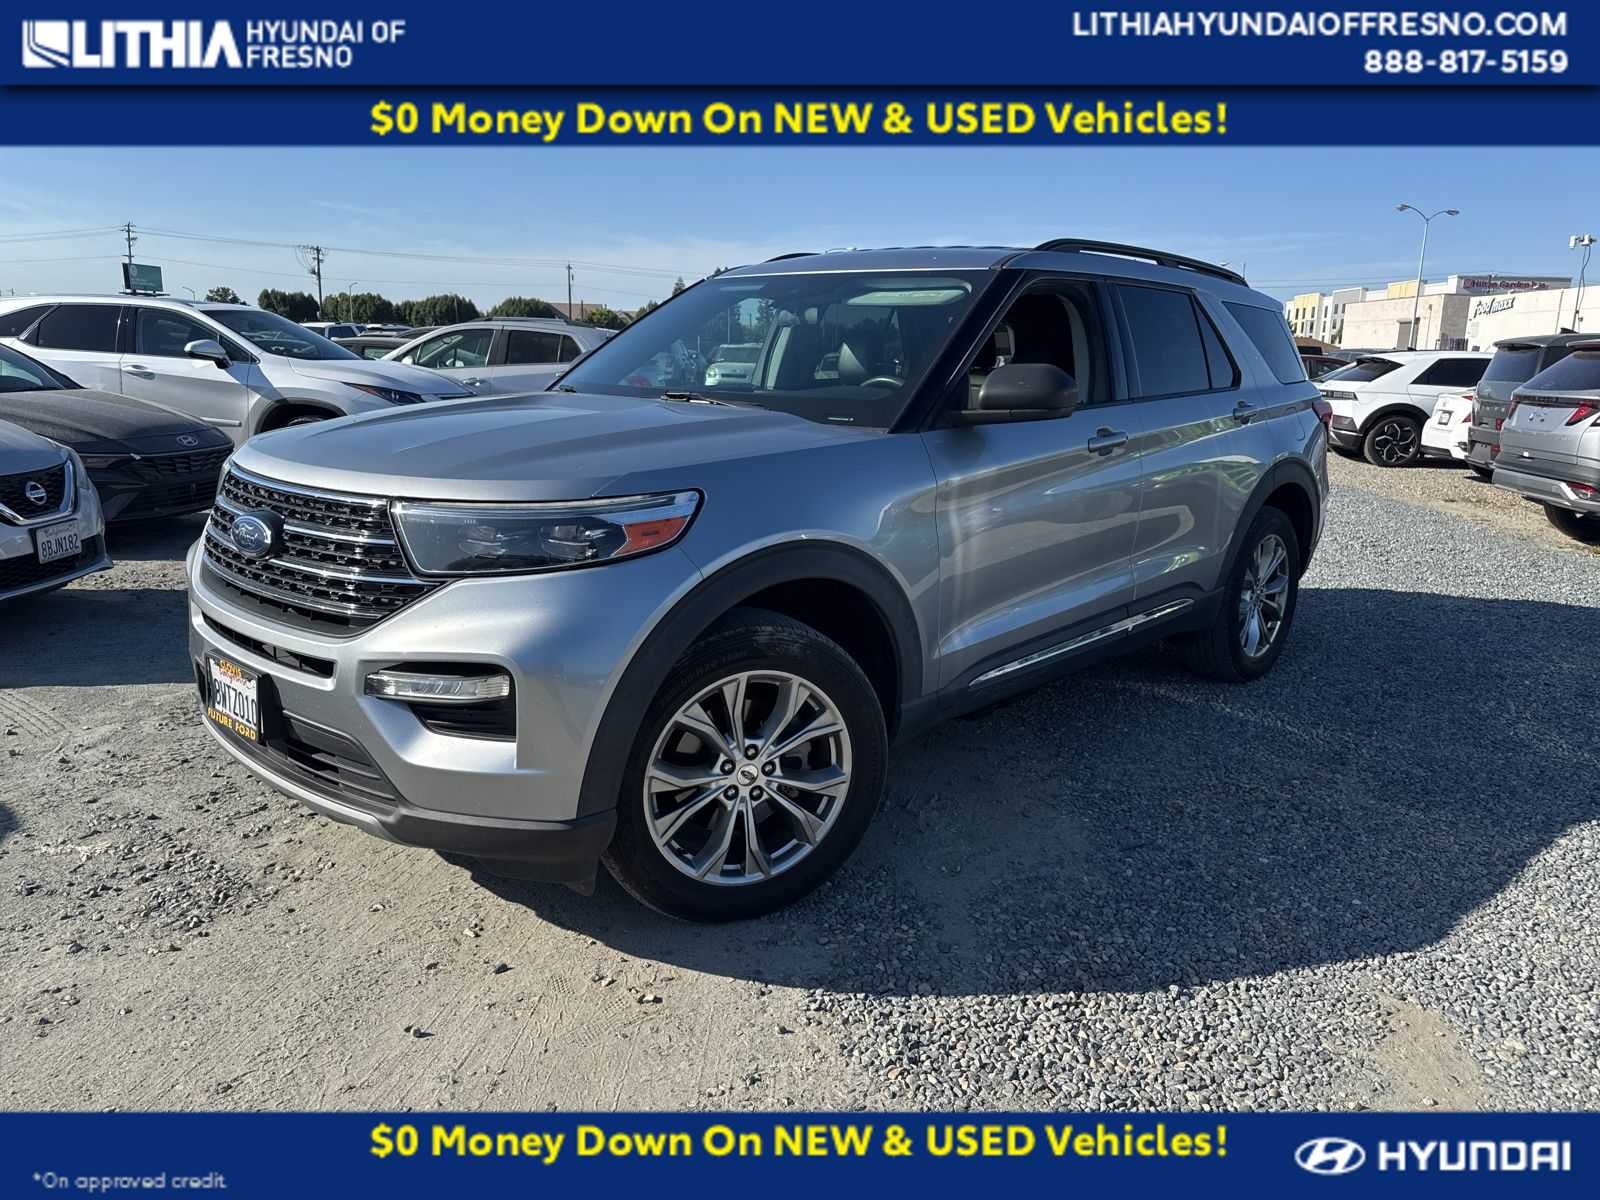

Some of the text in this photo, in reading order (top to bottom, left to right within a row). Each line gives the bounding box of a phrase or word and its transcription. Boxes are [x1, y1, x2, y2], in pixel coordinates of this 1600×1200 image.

[41, 534, 79, 558] 8BJN182
[208, 707, 256, 740] FUTURE FORD
